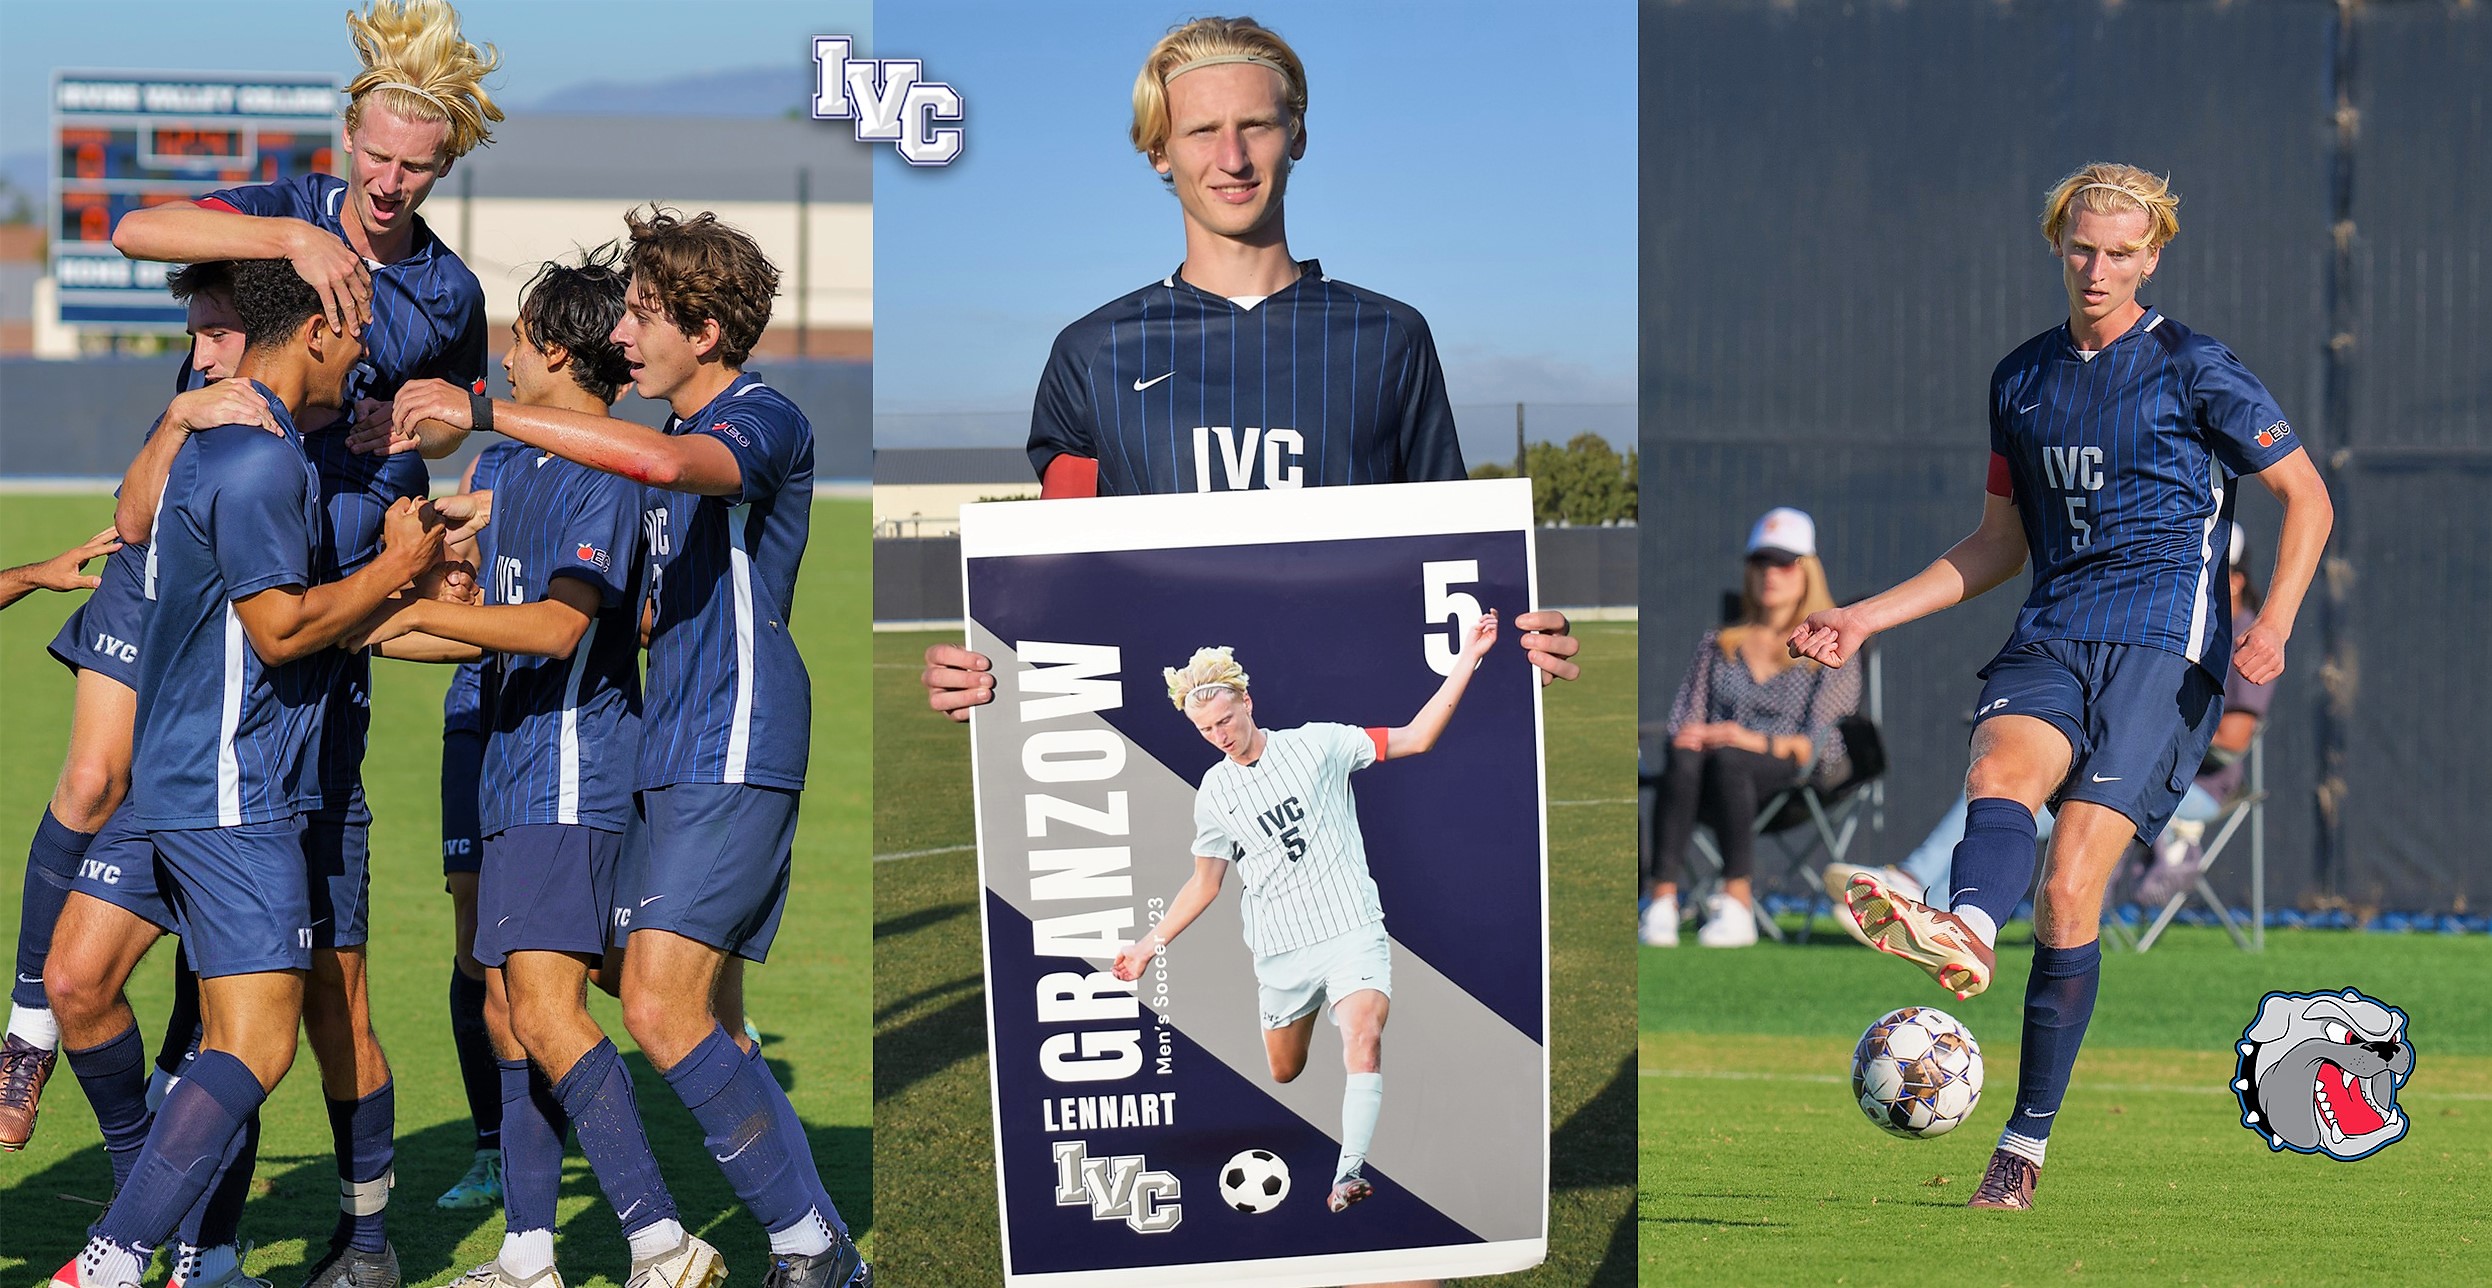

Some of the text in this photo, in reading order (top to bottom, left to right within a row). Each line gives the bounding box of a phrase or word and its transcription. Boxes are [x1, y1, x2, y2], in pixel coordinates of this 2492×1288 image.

[1193, 427, 1304, 492] IVC
[2042, 446, 2104, 490] IVC
[2065, 497, 2091, 551] 5
[1422, 560, 1483, 676] 5
[93, 632, 138, 664] IVC
[1256, 796, 1305, 837] IVC
[1016, 640, 1143, 1083] GRANZOW
[1279, 826, 1306, 863] 5
[78, 859, 121, 885] IVC
[1153, 935, 1169, 1008] Soccer
[1155, 1014, 1173, 1075] Men's
[1043, 1093, 1176, 1132] LENNART
[1052, 1140, 1183, 1235] IVC
